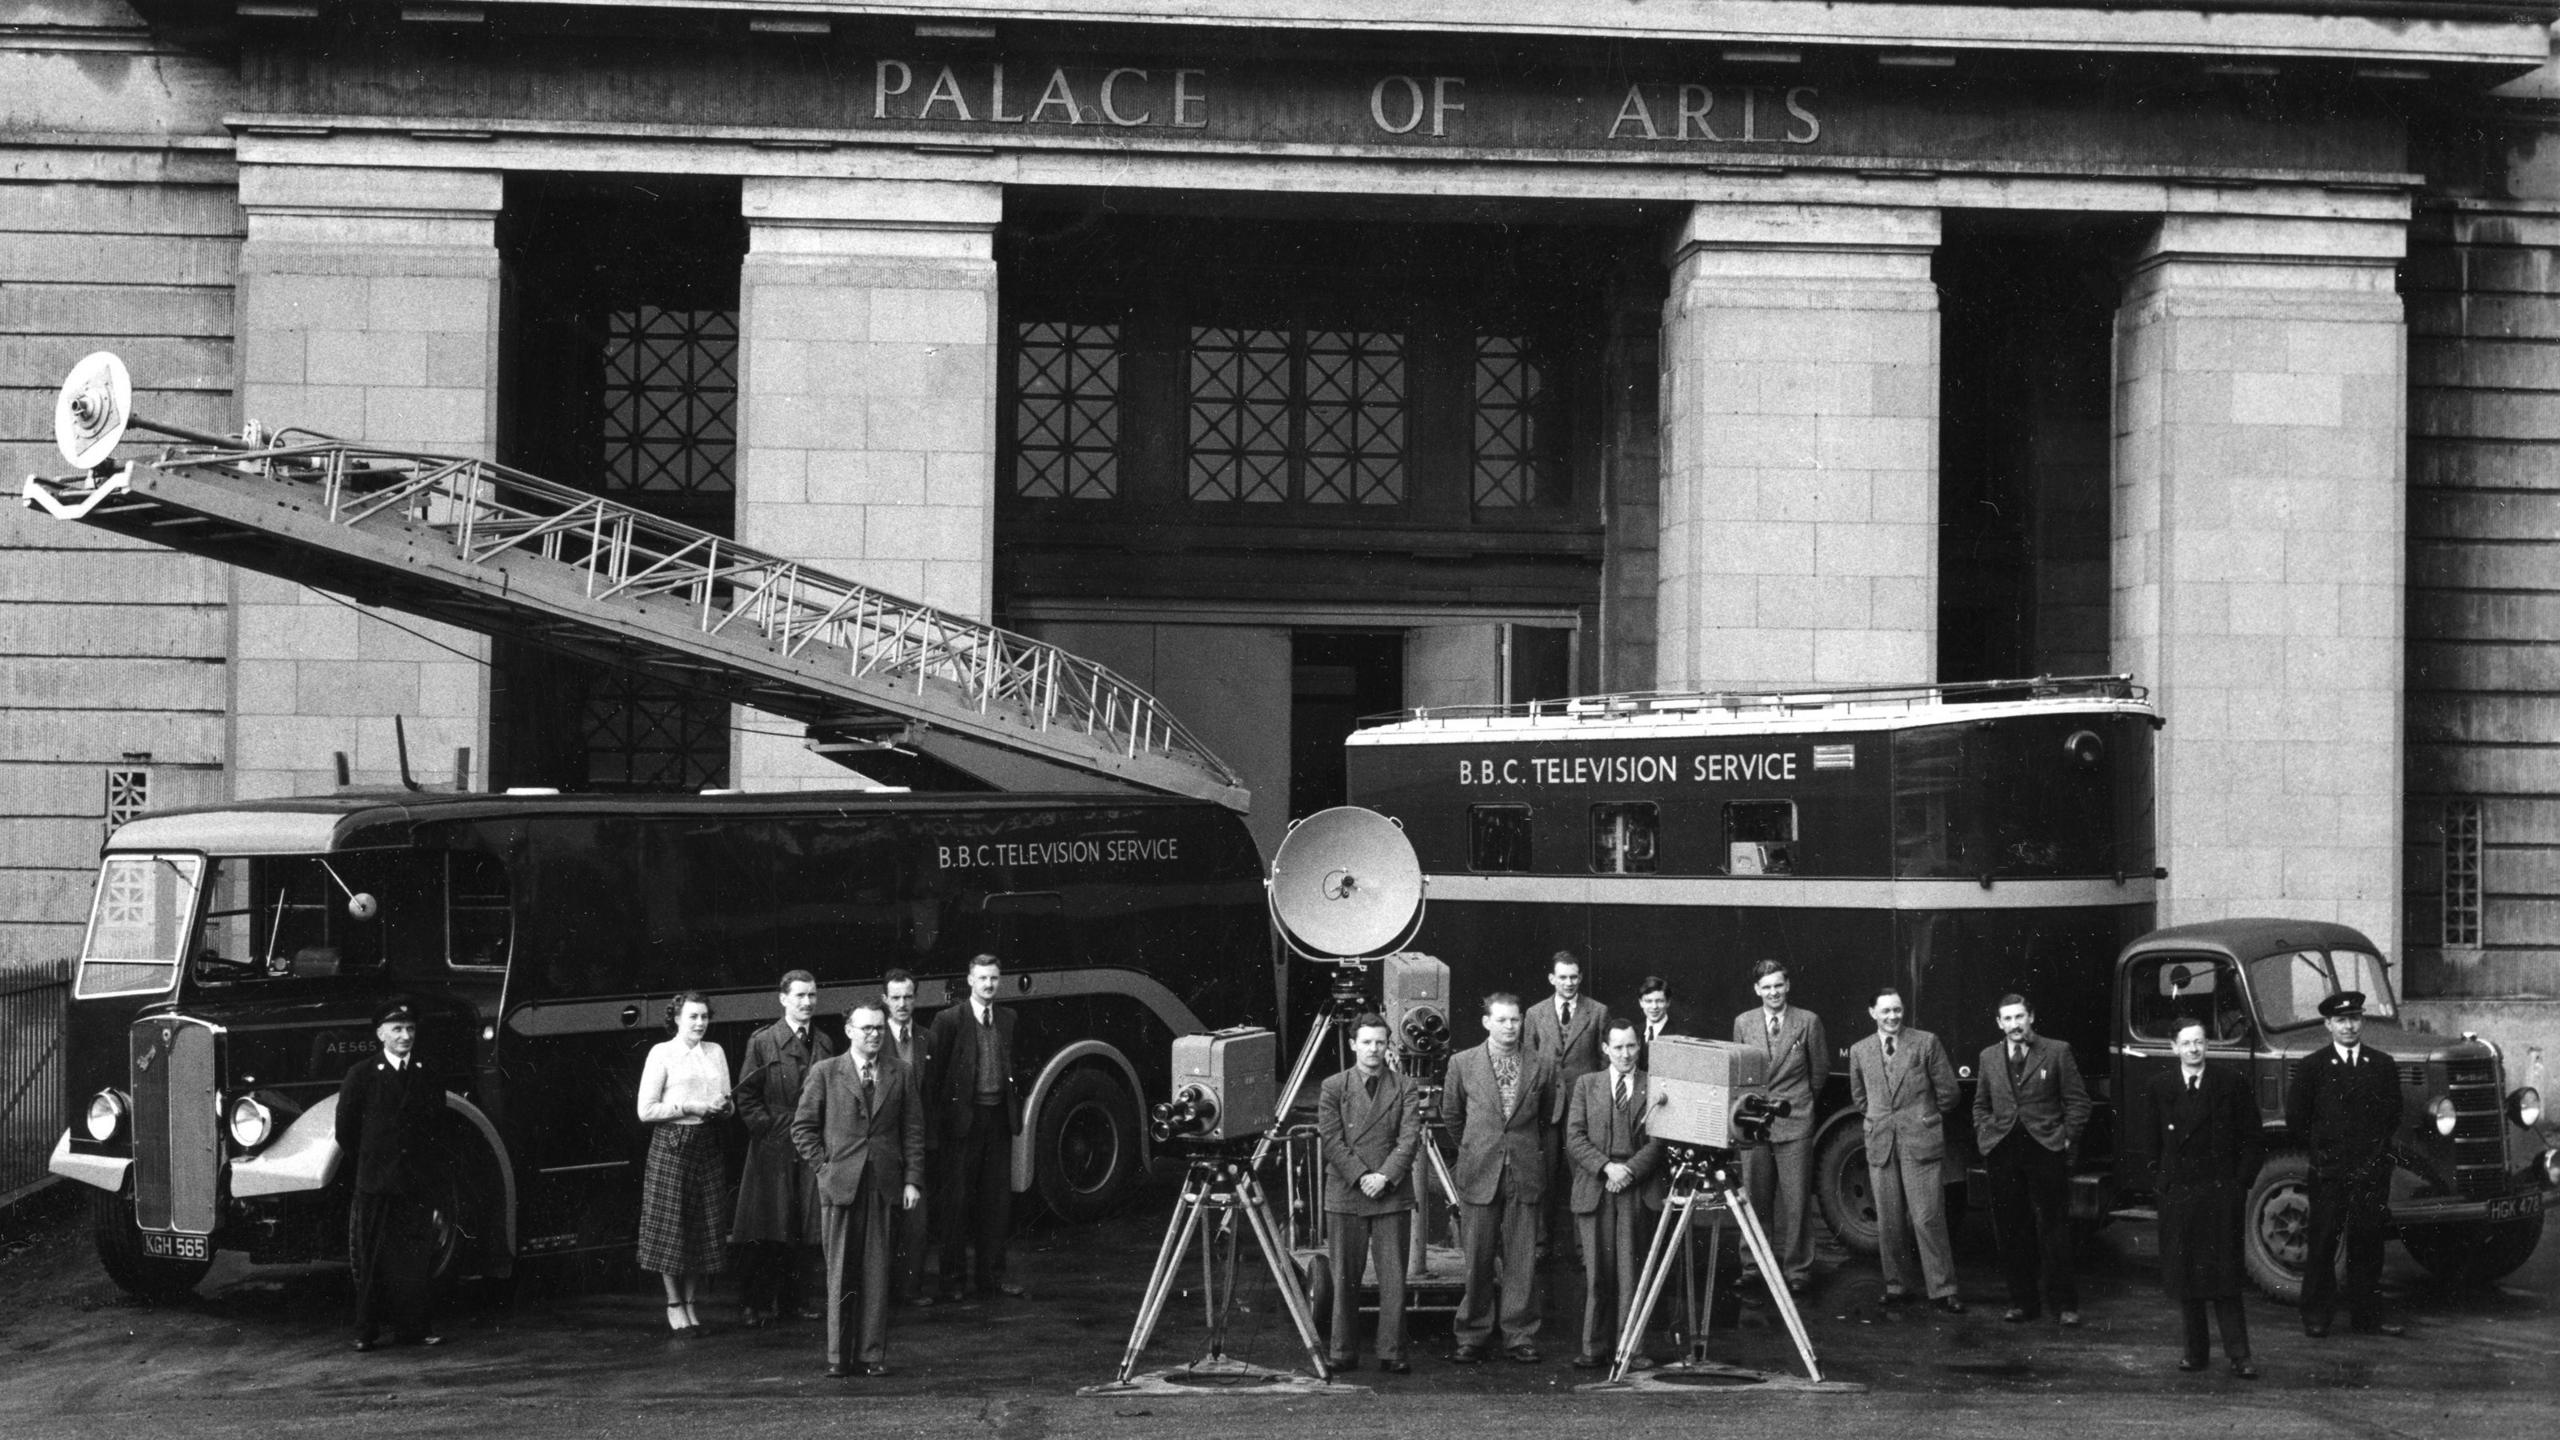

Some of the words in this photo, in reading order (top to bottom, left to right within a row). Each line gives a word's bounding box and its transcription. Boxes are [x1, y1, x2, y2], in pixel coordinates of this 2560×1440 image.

[873, 59, 1208, 128] PALACE
[1370, 75, 1465, 138] OF
[1607, 83, 1820, 144] ARTS
[1459, 759, 1526, 785] B.B.C.
[1531, 756, 1677, 784] TELEVISION
[1694, 753, 1797, 782] SERVICE
[938, 845, 995, 869] B.B.C.
[996, 841, 1100, 866] TELEVISION
[1107, 838, 1179, 862] SERVICE
[2491, 1199, 2517, 1220] HGK
[145, 1235, 172, 1255] KGH
[175, 1237, 204, 1258] 565
